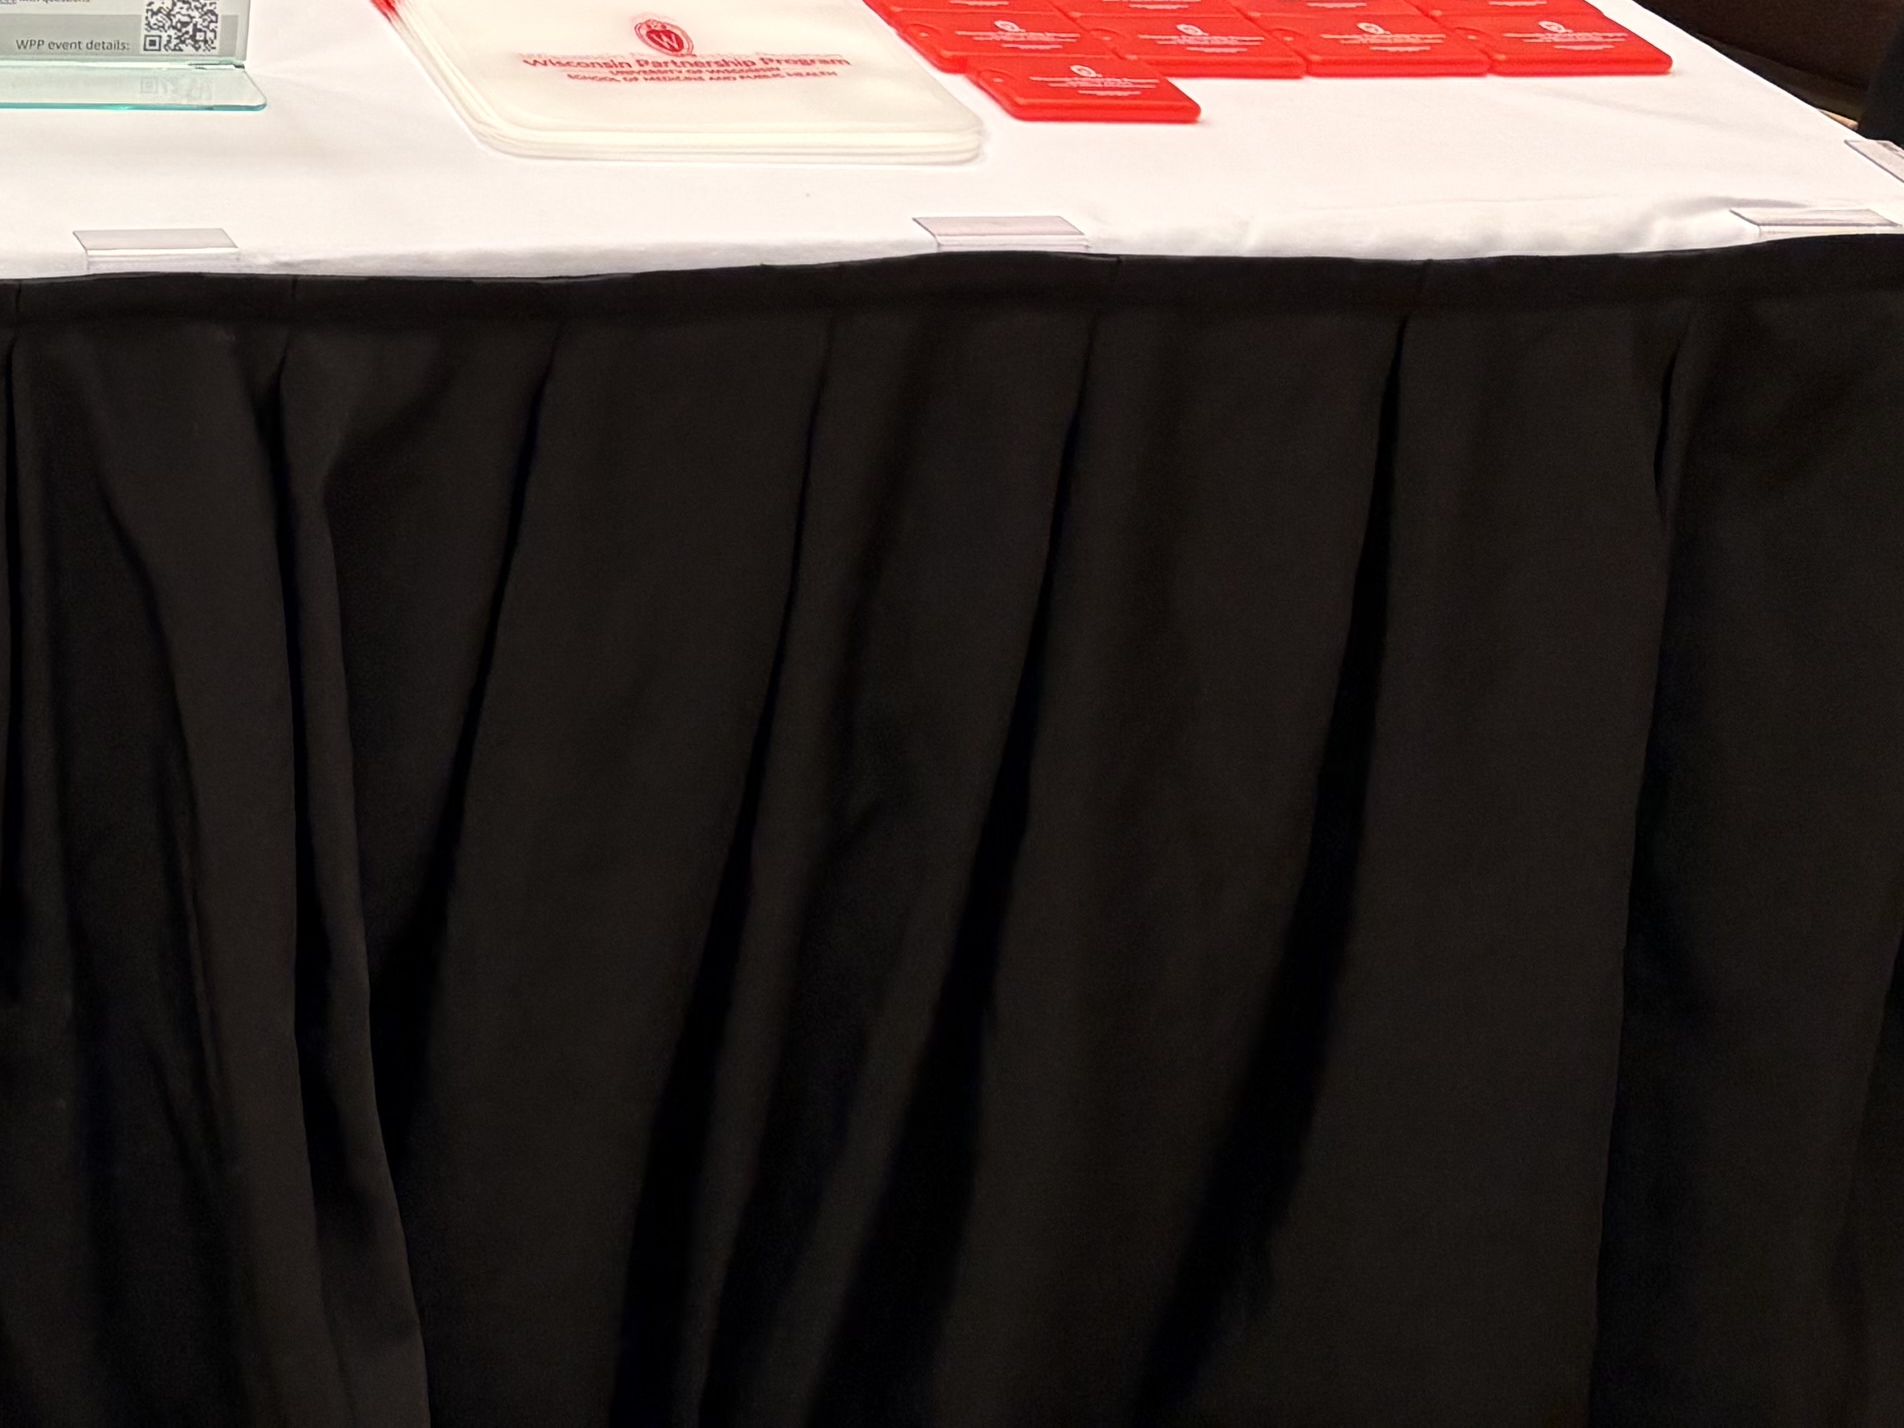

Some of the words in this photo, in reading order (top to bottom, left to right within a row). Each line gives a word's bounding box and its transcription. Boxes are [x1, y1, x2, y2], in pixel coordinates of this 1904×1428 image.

[16, 39, 44, 49] WPP
[48, 41, 81, 50] event
[86, 40, 129, 50] details:
[650, 31, 681, 51] W
[523, 57, 632, 70] Wisconsin
[636, 57, 757, 69] Partnership
[760, 57, 851, 67] Program
